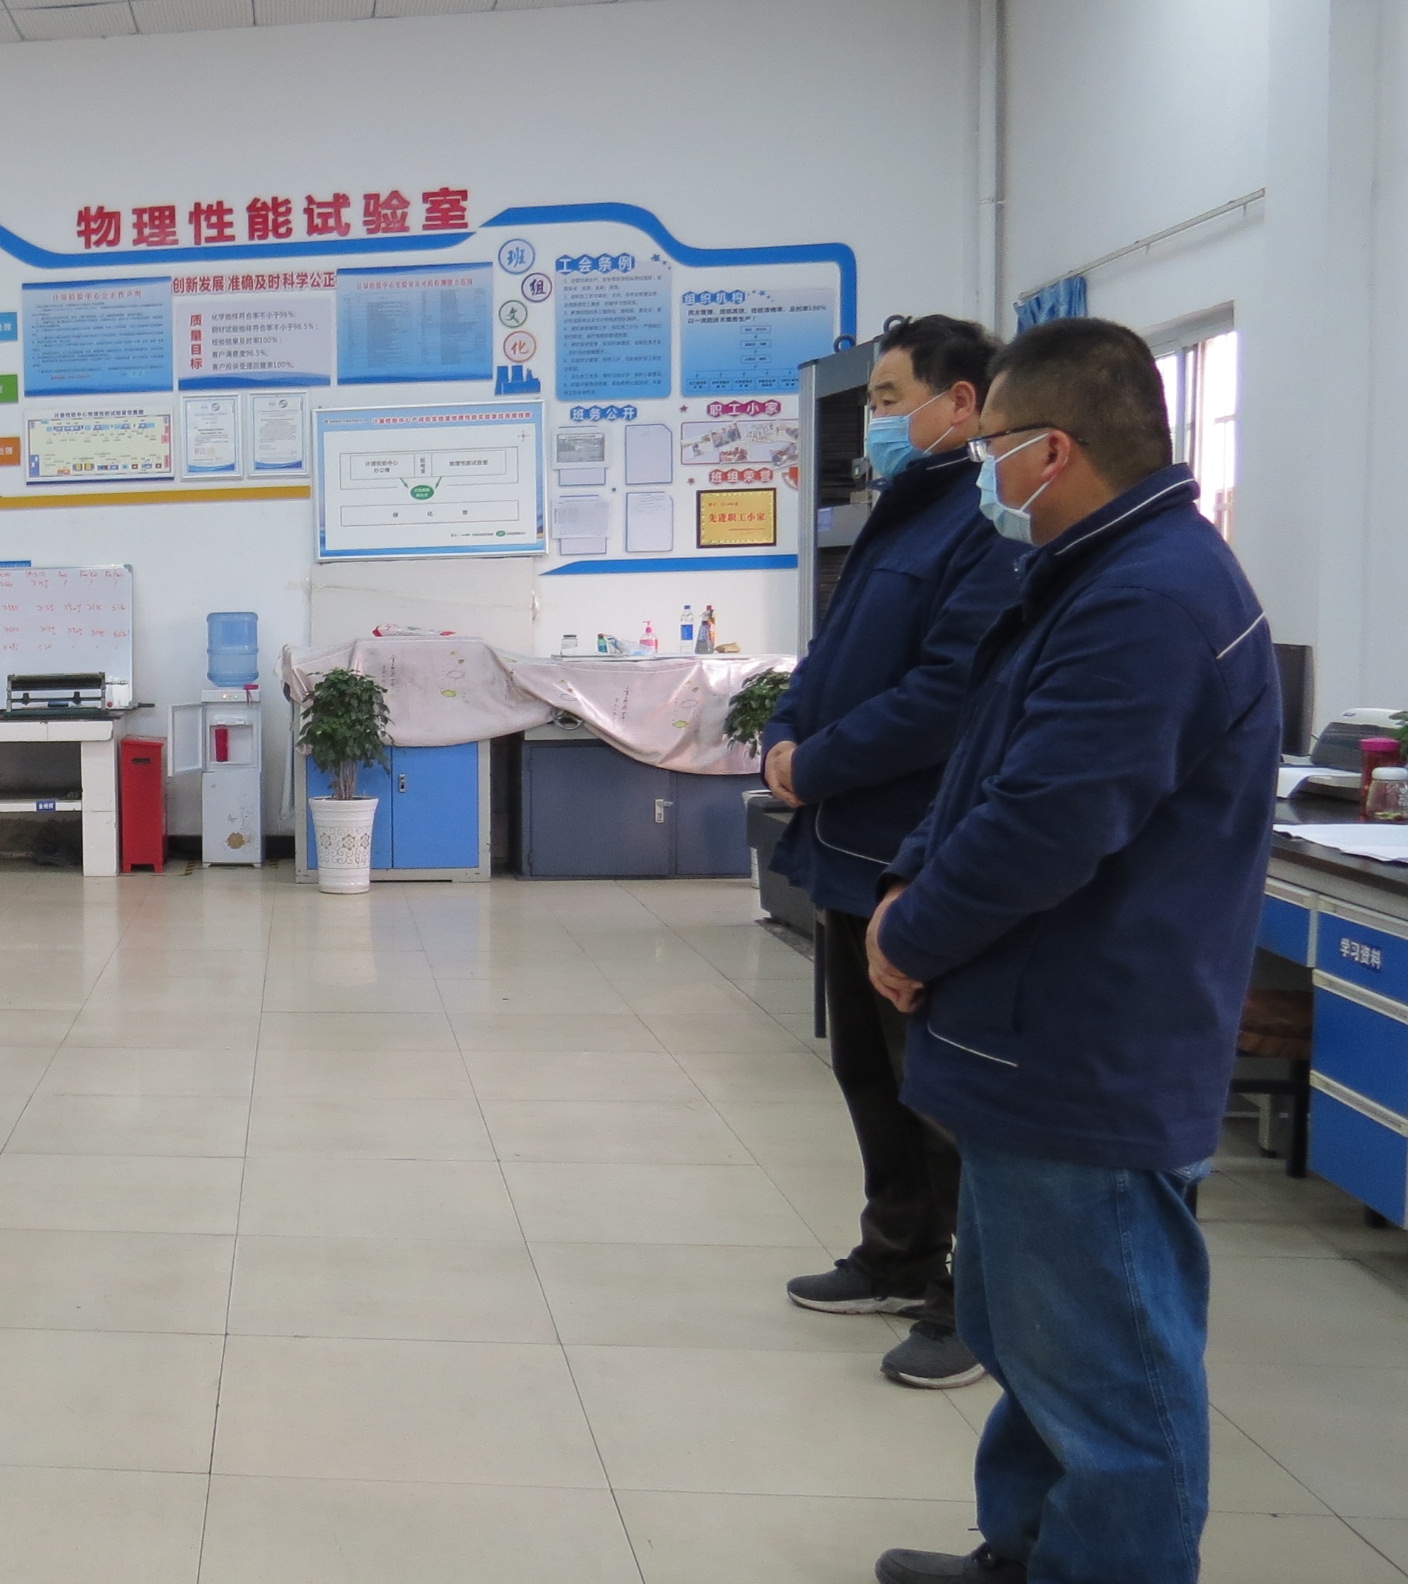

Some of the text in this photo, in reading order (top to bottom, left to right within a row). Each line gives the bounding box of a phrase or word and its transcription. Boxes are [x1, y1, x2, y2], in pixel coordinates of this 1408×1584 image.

[76, 187, 470, 250] 物理性能试验室
[558, 255, 632, 273] 工会条例
[173, 271, 336, 294] 创新发展 准确及时 科学公正
[684, 292, 743, 305] 组织机构
[190, 314, 203, 370] 质量目标
[573, 406, 635, 420] 班务公开
[710, 402, 780, 416] 职工小家
[710, 469, 772, 483] 班组荣誉
[1340, 937, 1381, 969] 学习资料
